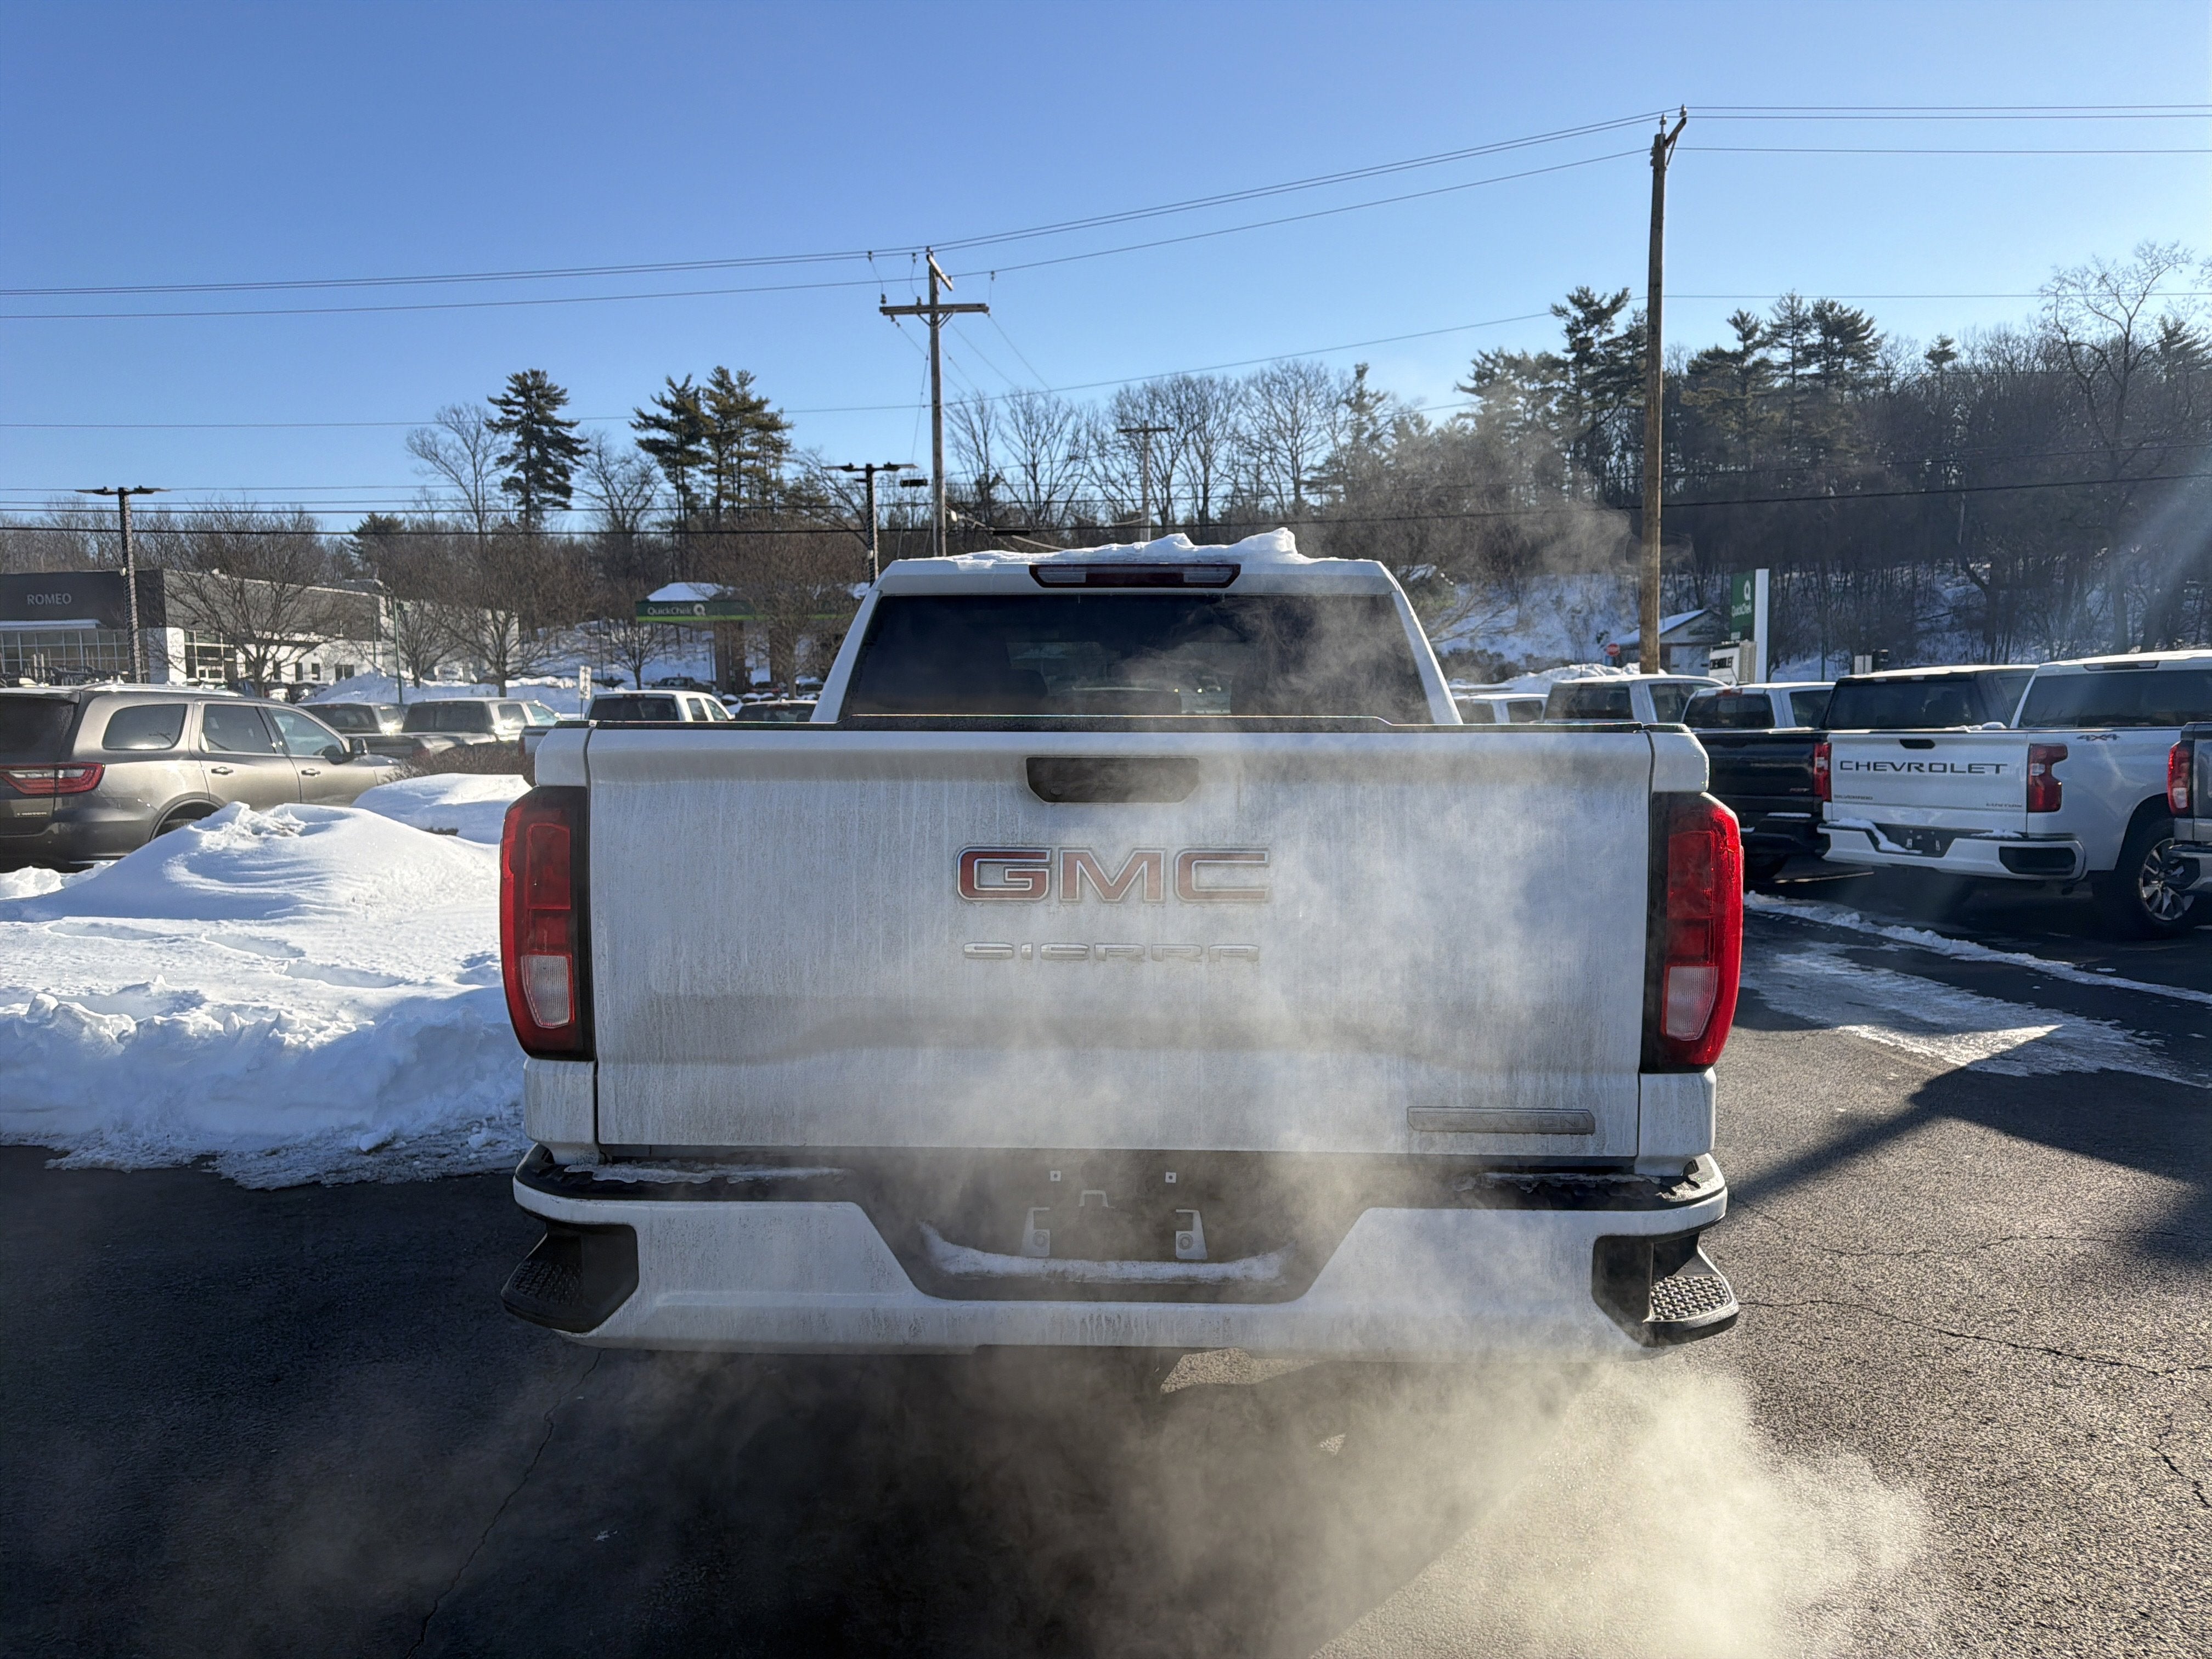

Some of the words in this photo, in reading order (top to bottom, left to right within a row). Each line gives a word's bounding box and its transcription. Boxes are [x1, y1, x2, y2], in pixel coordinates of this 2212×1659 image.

[26, 592, 72, 605] ROMEO
[647, 606, 691, 615] QuickChek
[1839, 760, 2008, 774] CHEVROLET
[956, 846, 1269, 902] GMC
[964, 943, 1260, 962] SIERRA
